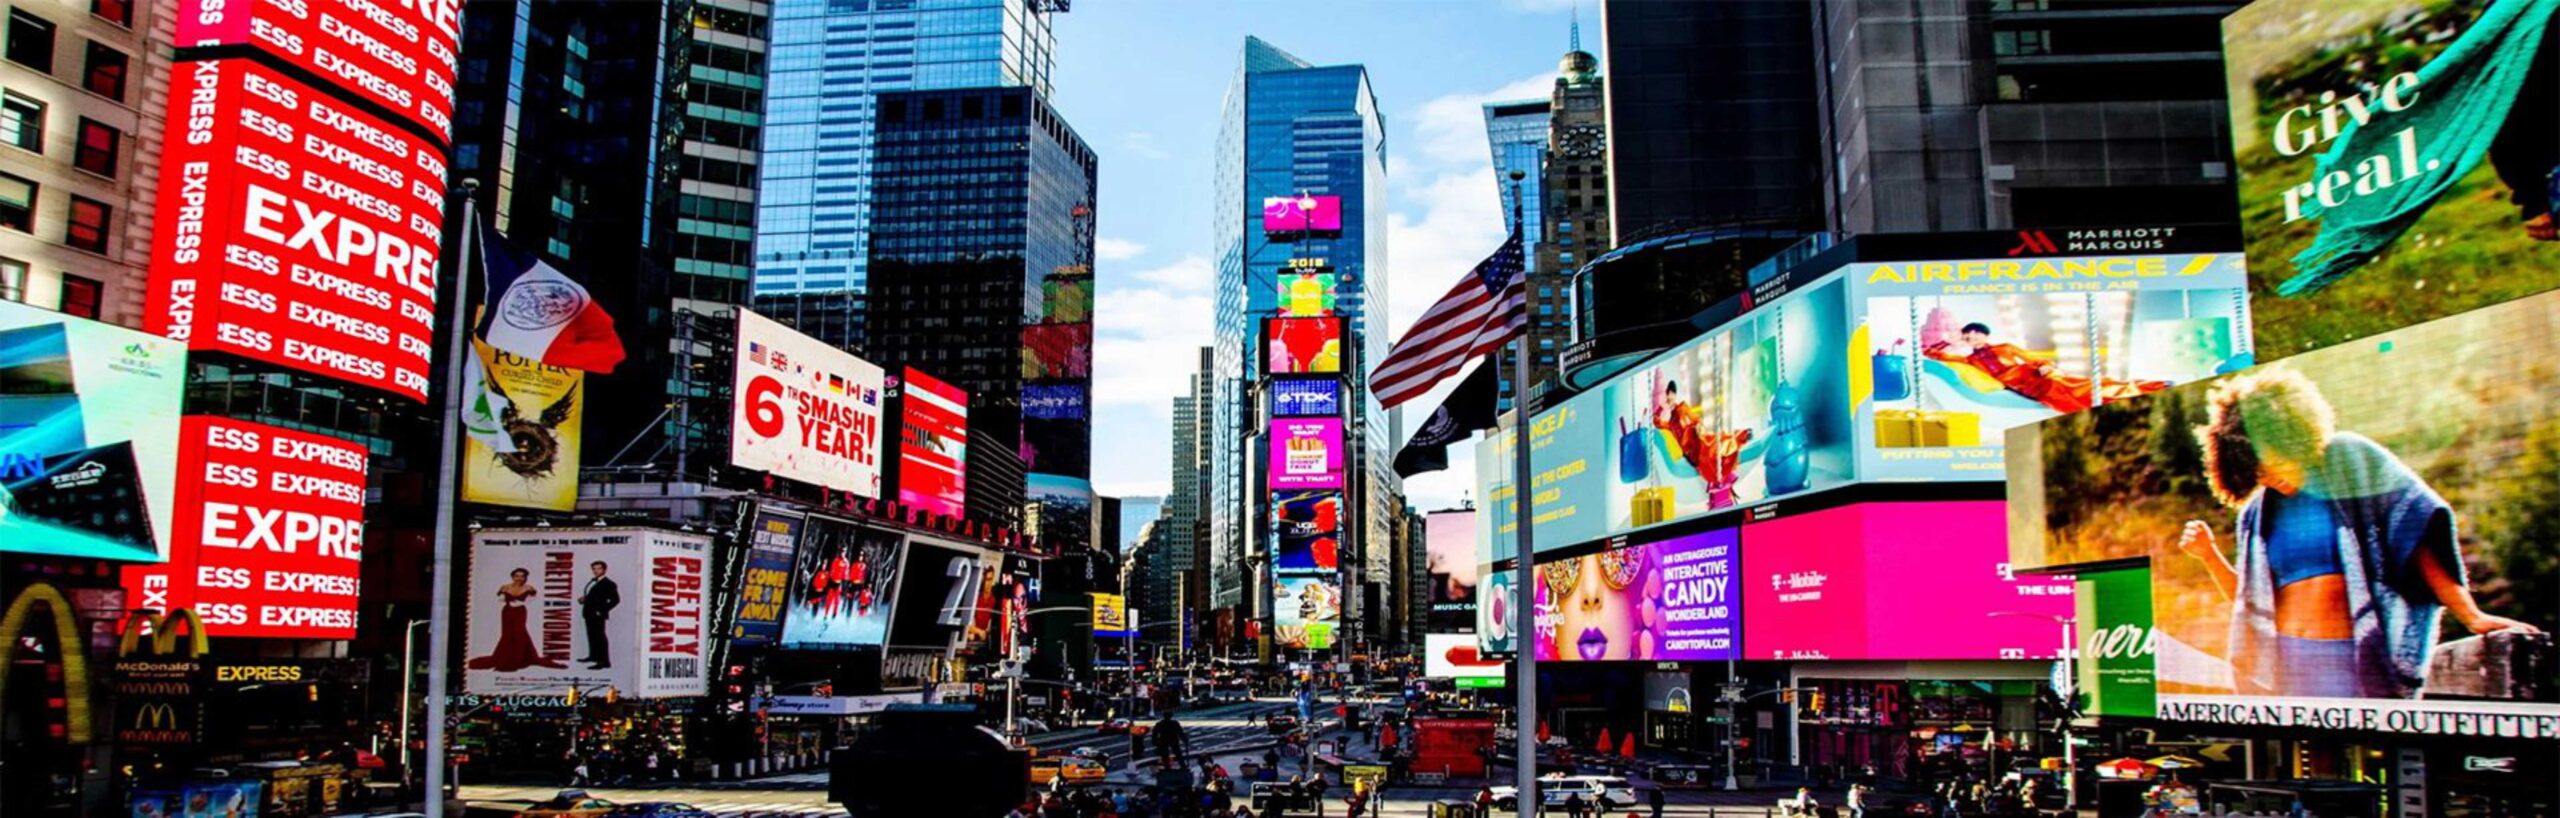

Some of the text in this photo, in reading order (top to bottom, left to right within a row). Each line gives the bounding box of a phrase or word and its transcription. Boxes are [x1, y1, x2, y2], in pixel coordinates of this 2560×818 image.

[319, 12, 418, 76] EXPRESS
[313, 47, 413, 109] EXPRESS
[309, 100, 409, 159] EXPRESS
[2273, 70, 2421, 157] Give
[304, 133, 404, 189] EXPRESS
[2279, 125, 2441, 225] real.
[173, 161, 209, 264] EXPRESS
[301, 170, 402, 223] EXPRESS
[2068, 227, 2176, 240] MARRIOTT
[2068, 239, 2165, 251] MARQUIS
[290, 263, 393, 311] EXPRESS
[1866, 256, 2168, 285] AIRFRANCE
[1943, 283, 2016, 294] FRANCE
[2022, 283, 2040, 292] IS
[2043, 282, 2064, 292] IN
[2070, 281, 2102, 291] THE
[288, 300, 391, 345] EXPRESS
[283, 337, 386, 380] EXPRESS
[797, 390, 866, 434] SMASH
[1291, 392, 1333, 402] TDK
[271, 436, 363, 472] EXPRESS
[270, 471, 361, 505] EXPRESS
[264, 570, 355, 596] EXPRESS
[1663, 559, 1728, 581] INTERACTIVE
[649, 556, 677, 653] WOMAN
[675, 556, 702, 657] PRETTY
[1663, 576, 1729, 607] CANDY
[260, 605, 352, 629] EXPRESS
[1665, 606, 1729, 622] WONDERLAND
[115, 662, 201, 672] McDonald's
[216, 665, 302, 682] EXPRESS
[2160, 702, 2282, 725] AMERICAN
[2293, 706, 2379, 731] EAGLE
